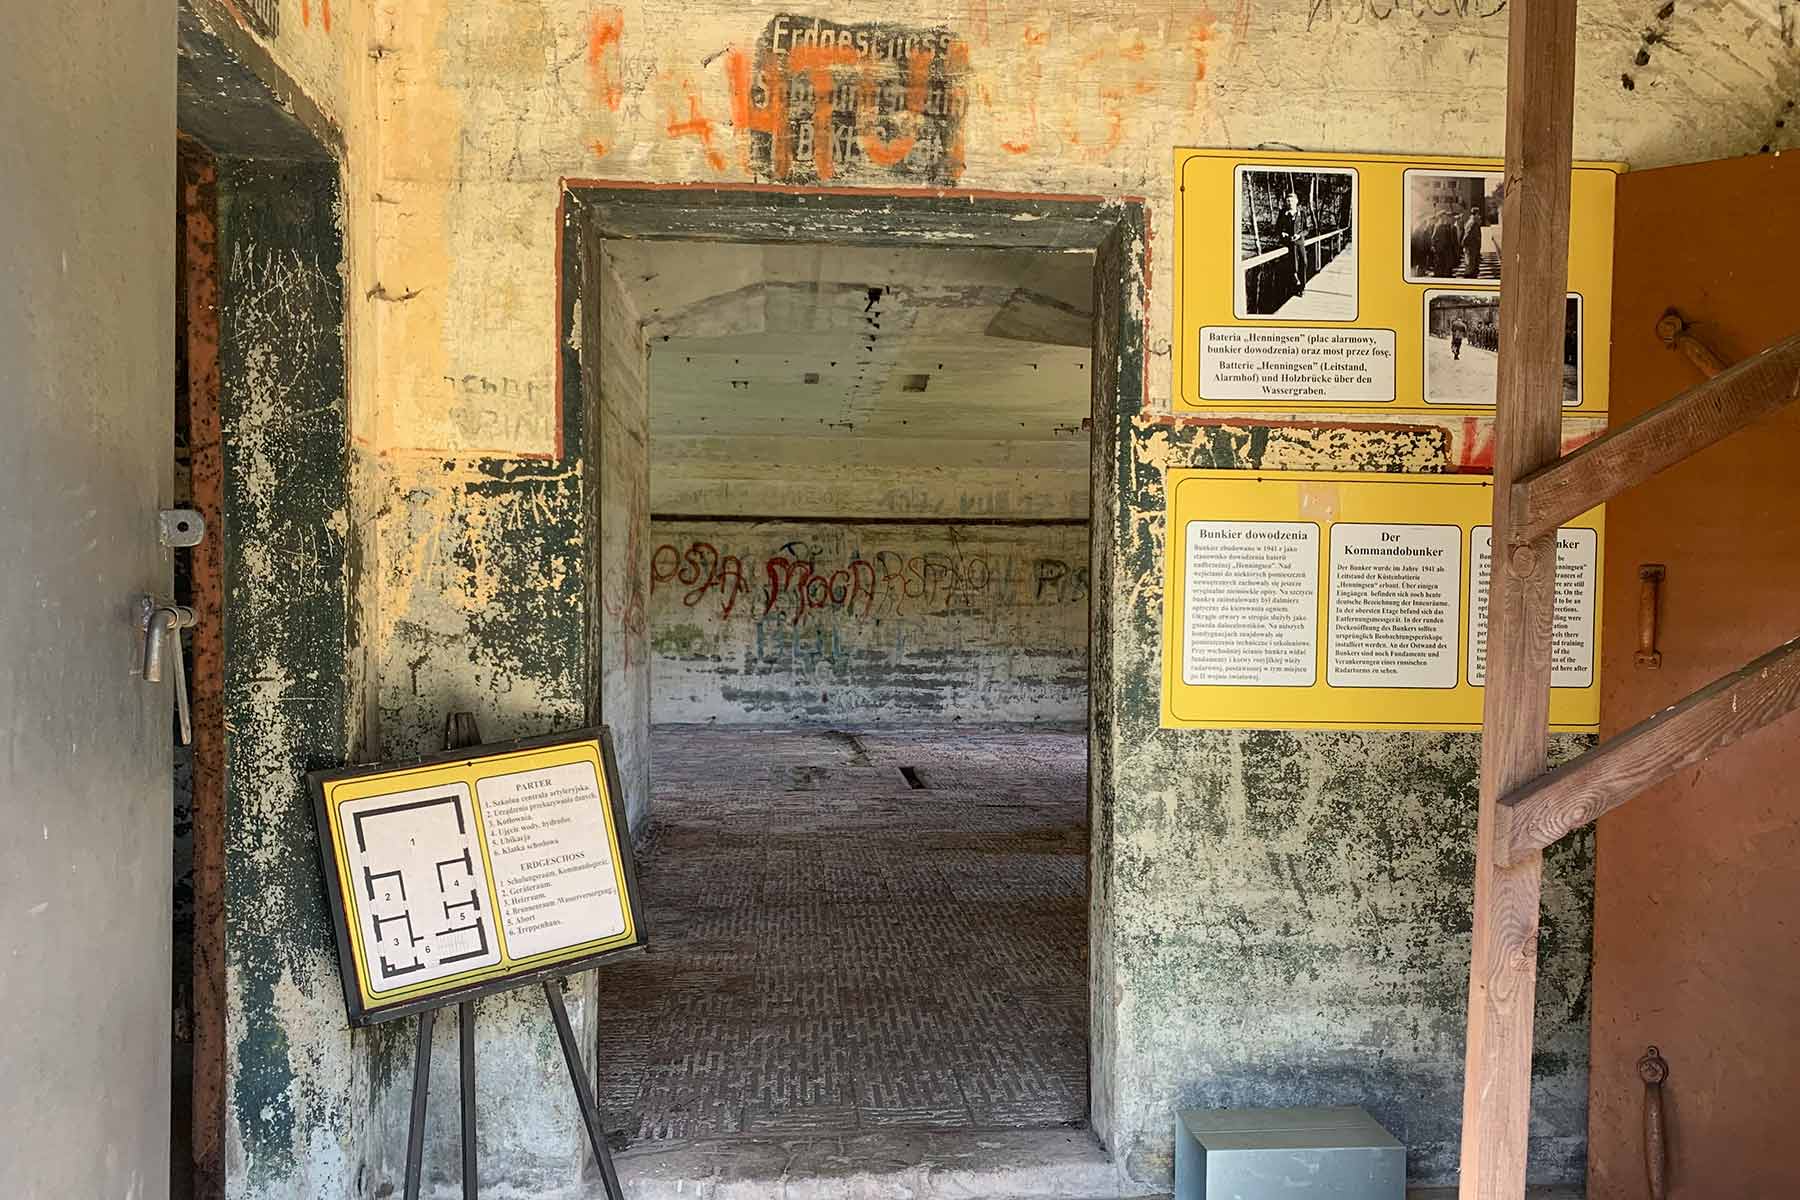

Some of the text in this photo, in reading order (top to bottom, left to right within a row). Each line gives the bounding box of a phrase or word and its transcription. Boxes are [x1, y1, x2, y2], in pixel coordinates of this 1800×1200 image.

[1209, 333, 1241, 341] Bateria
[1307, 334, 1328, 345] (plac
[1331, 335, 1376, 346] alarmowy,
[1207, 345, 1241, 354] bunkier
[1244, 346, 1298, 356] dowodzenia)
[1323, 347, 1343, 355] most
[1346, 349, 1369, 358] przez
[1372, 347, 1392, 358] fosę.
[1219, 361, 1253, 369] Batterie
[1320, 362, 1367, 373] (Leitstand,
[1215, 373, 1372, 384] Alarmhof) und Holzbrücke über den
[1262, 386, 1326, 397] Wassergraben.
[1200, 528, 1308, 540] Bunkier dowodzenia
[1381, 532, 1400, 542] Der
[1555, 539, 1580, 548] nker
[1344, 545, 1443, 556] Kommandobunker
[516, 778, 553, 791] PARTER
[410, 838, 416, 846] 1
[520, 851, 586, 871] ERDGESCHOSS
[453, 879, 460, 888] 4
[384, 893, 392, 902] 2
[460, 912, 466, 921] 5
[393, 937, 400, 946] 3
[425, 945, 431, 954] 6
